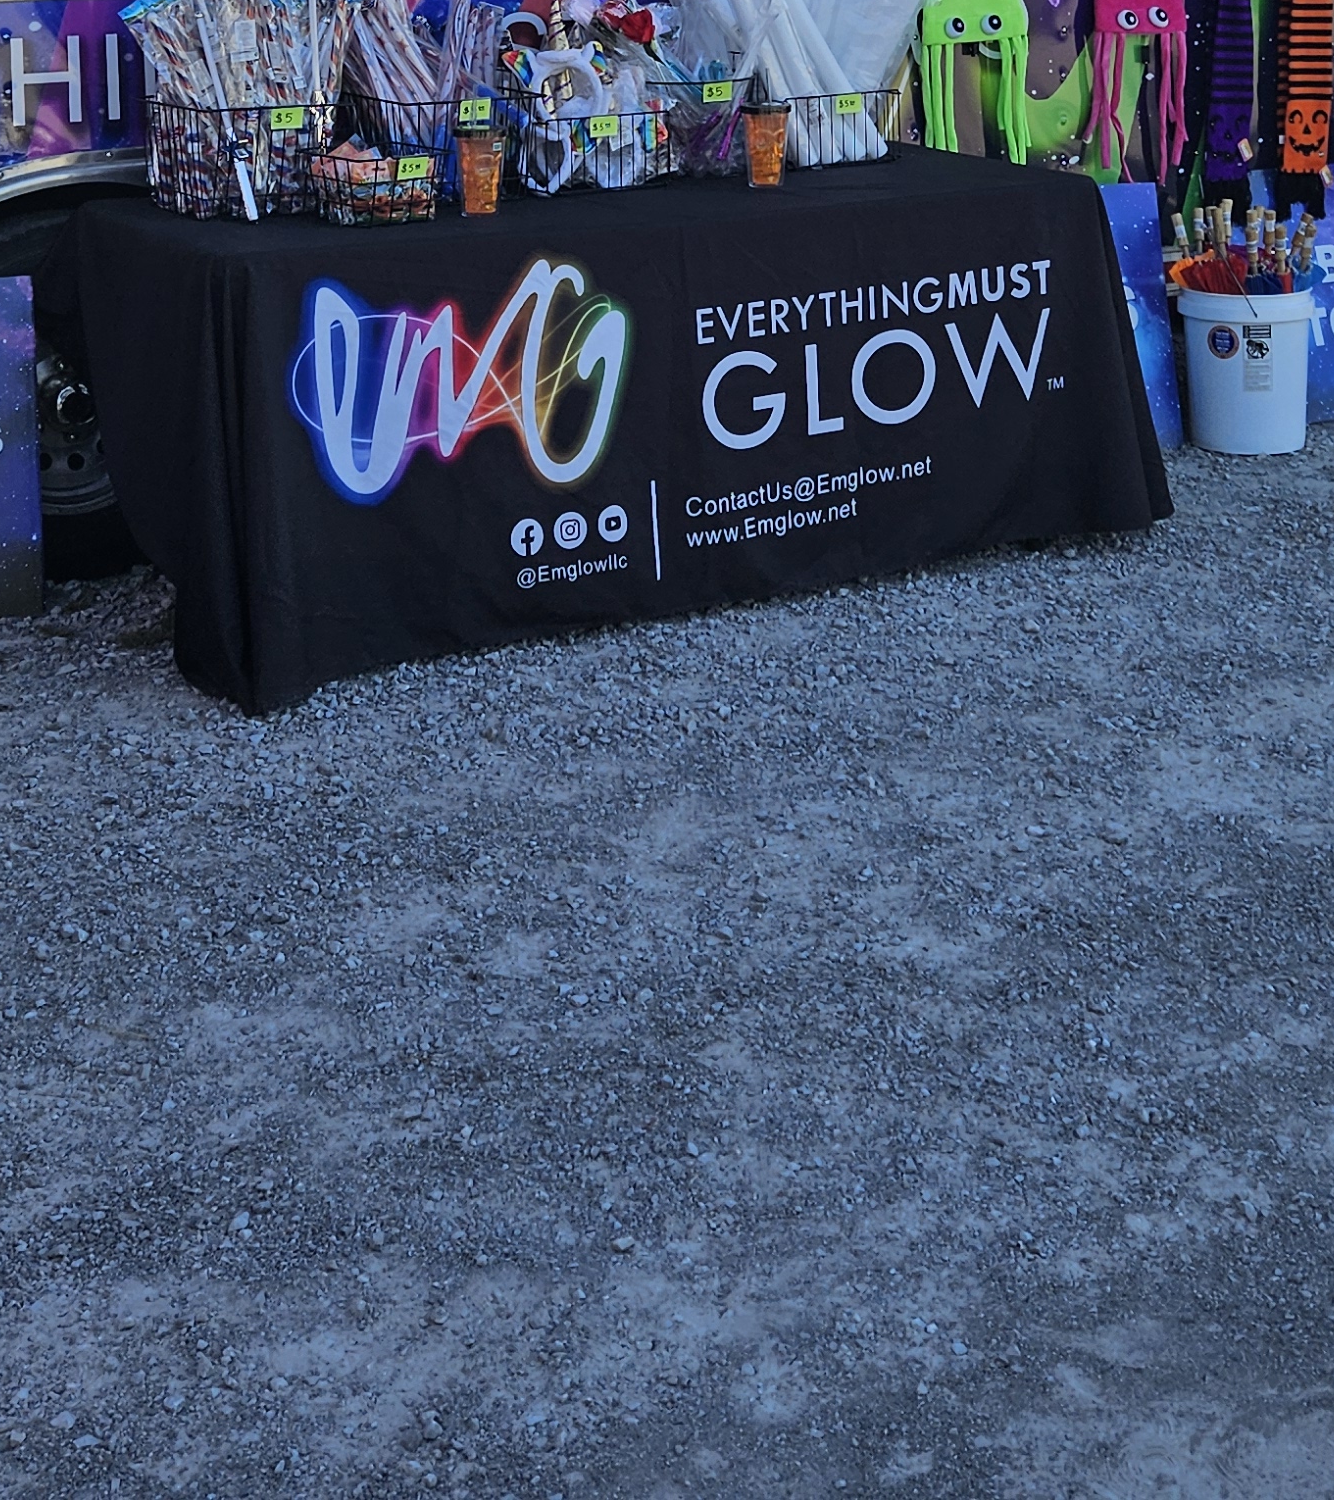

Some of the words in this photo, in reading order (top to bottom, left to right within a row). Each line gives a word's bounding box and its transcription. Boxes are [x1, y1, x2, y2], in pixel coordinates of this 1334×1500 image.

[707, 87, 723, 98] $5
[274, 112, 294, 124] $5
[702, 308, 1051, 450] GLOW
[685, 455, 933, 518] ContactUs@Emglow.net
[685, 498, 858, 548] www.Emglow.net
[516, 553, 628, 589] @Emglowllc
